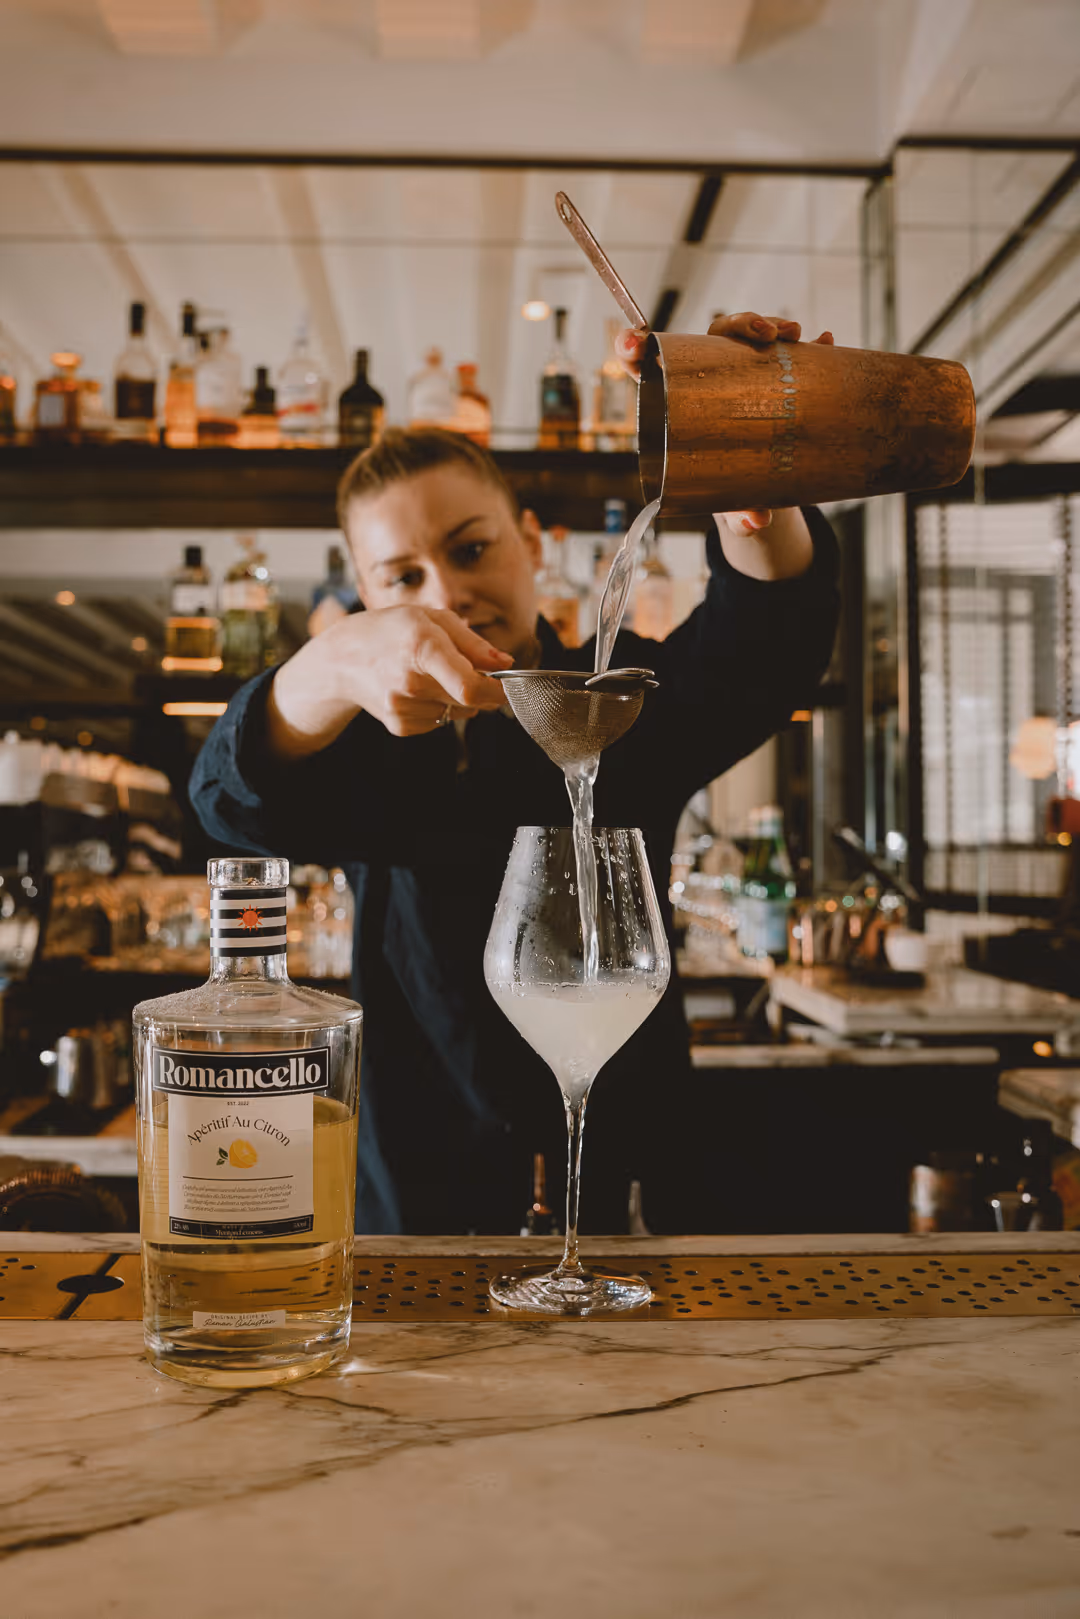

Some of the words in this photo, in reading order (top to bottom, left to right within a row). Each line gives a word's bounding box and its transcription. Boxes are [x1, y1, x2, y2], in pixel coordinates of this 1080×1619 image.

[159, 1055, 321, 1089] Romancello
[187, 1115, 231, 1145] Apéritif
[232, 1116, 250, 1128] Au
[253, 1118, 291, 1147] Citron
